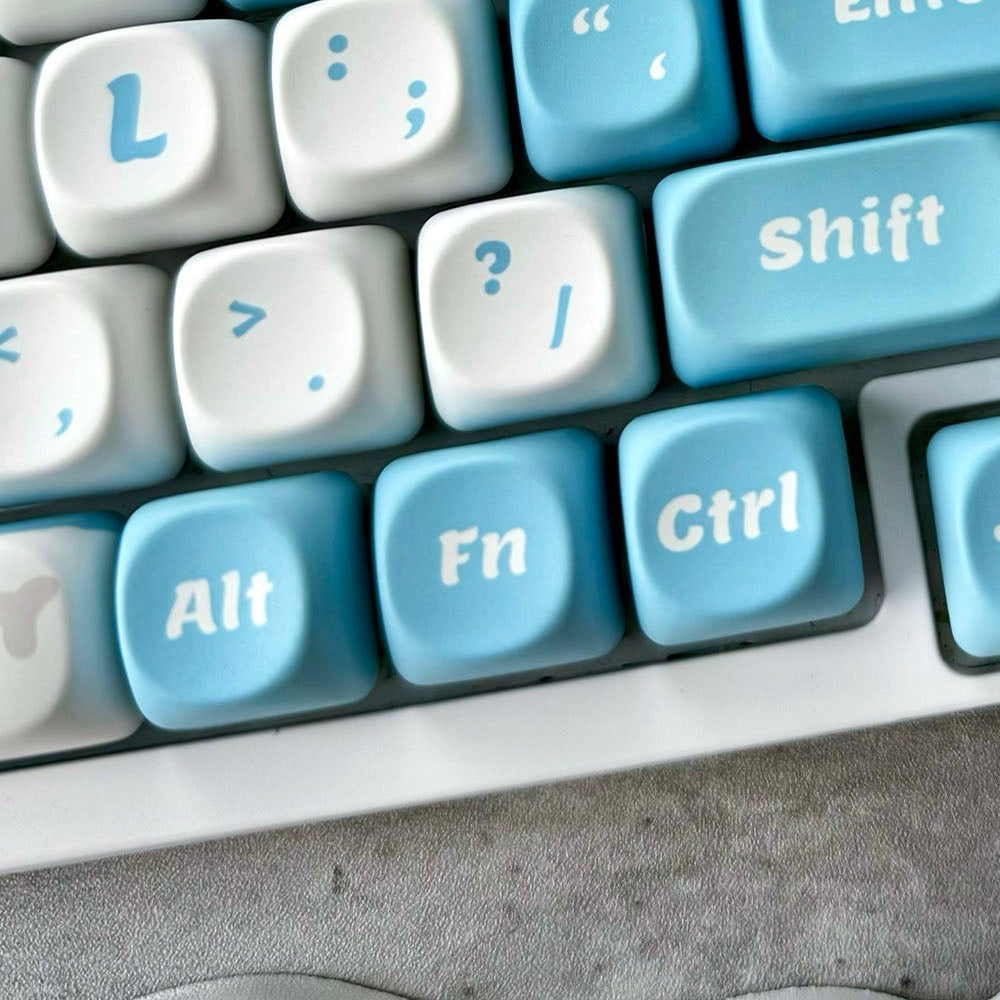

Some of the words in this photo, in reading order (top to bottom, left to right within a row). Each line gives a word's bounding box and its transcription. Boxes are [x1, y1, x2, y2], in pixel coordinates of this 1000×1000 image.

[327, 33, 348, 81] :
[106, 72, 167, 163] L
[404, 79, 427, 139] ;
[758, 192, 945, 271] Shift
[474, 240, 511, 295] ?
[229, 300, 266, 337] >
[549, 284, 572, 349] /
[656, 469, 800, 552] Ctrl
[439, 526, 527, 586] Fn
[165, 569, 274, 639] Alt
